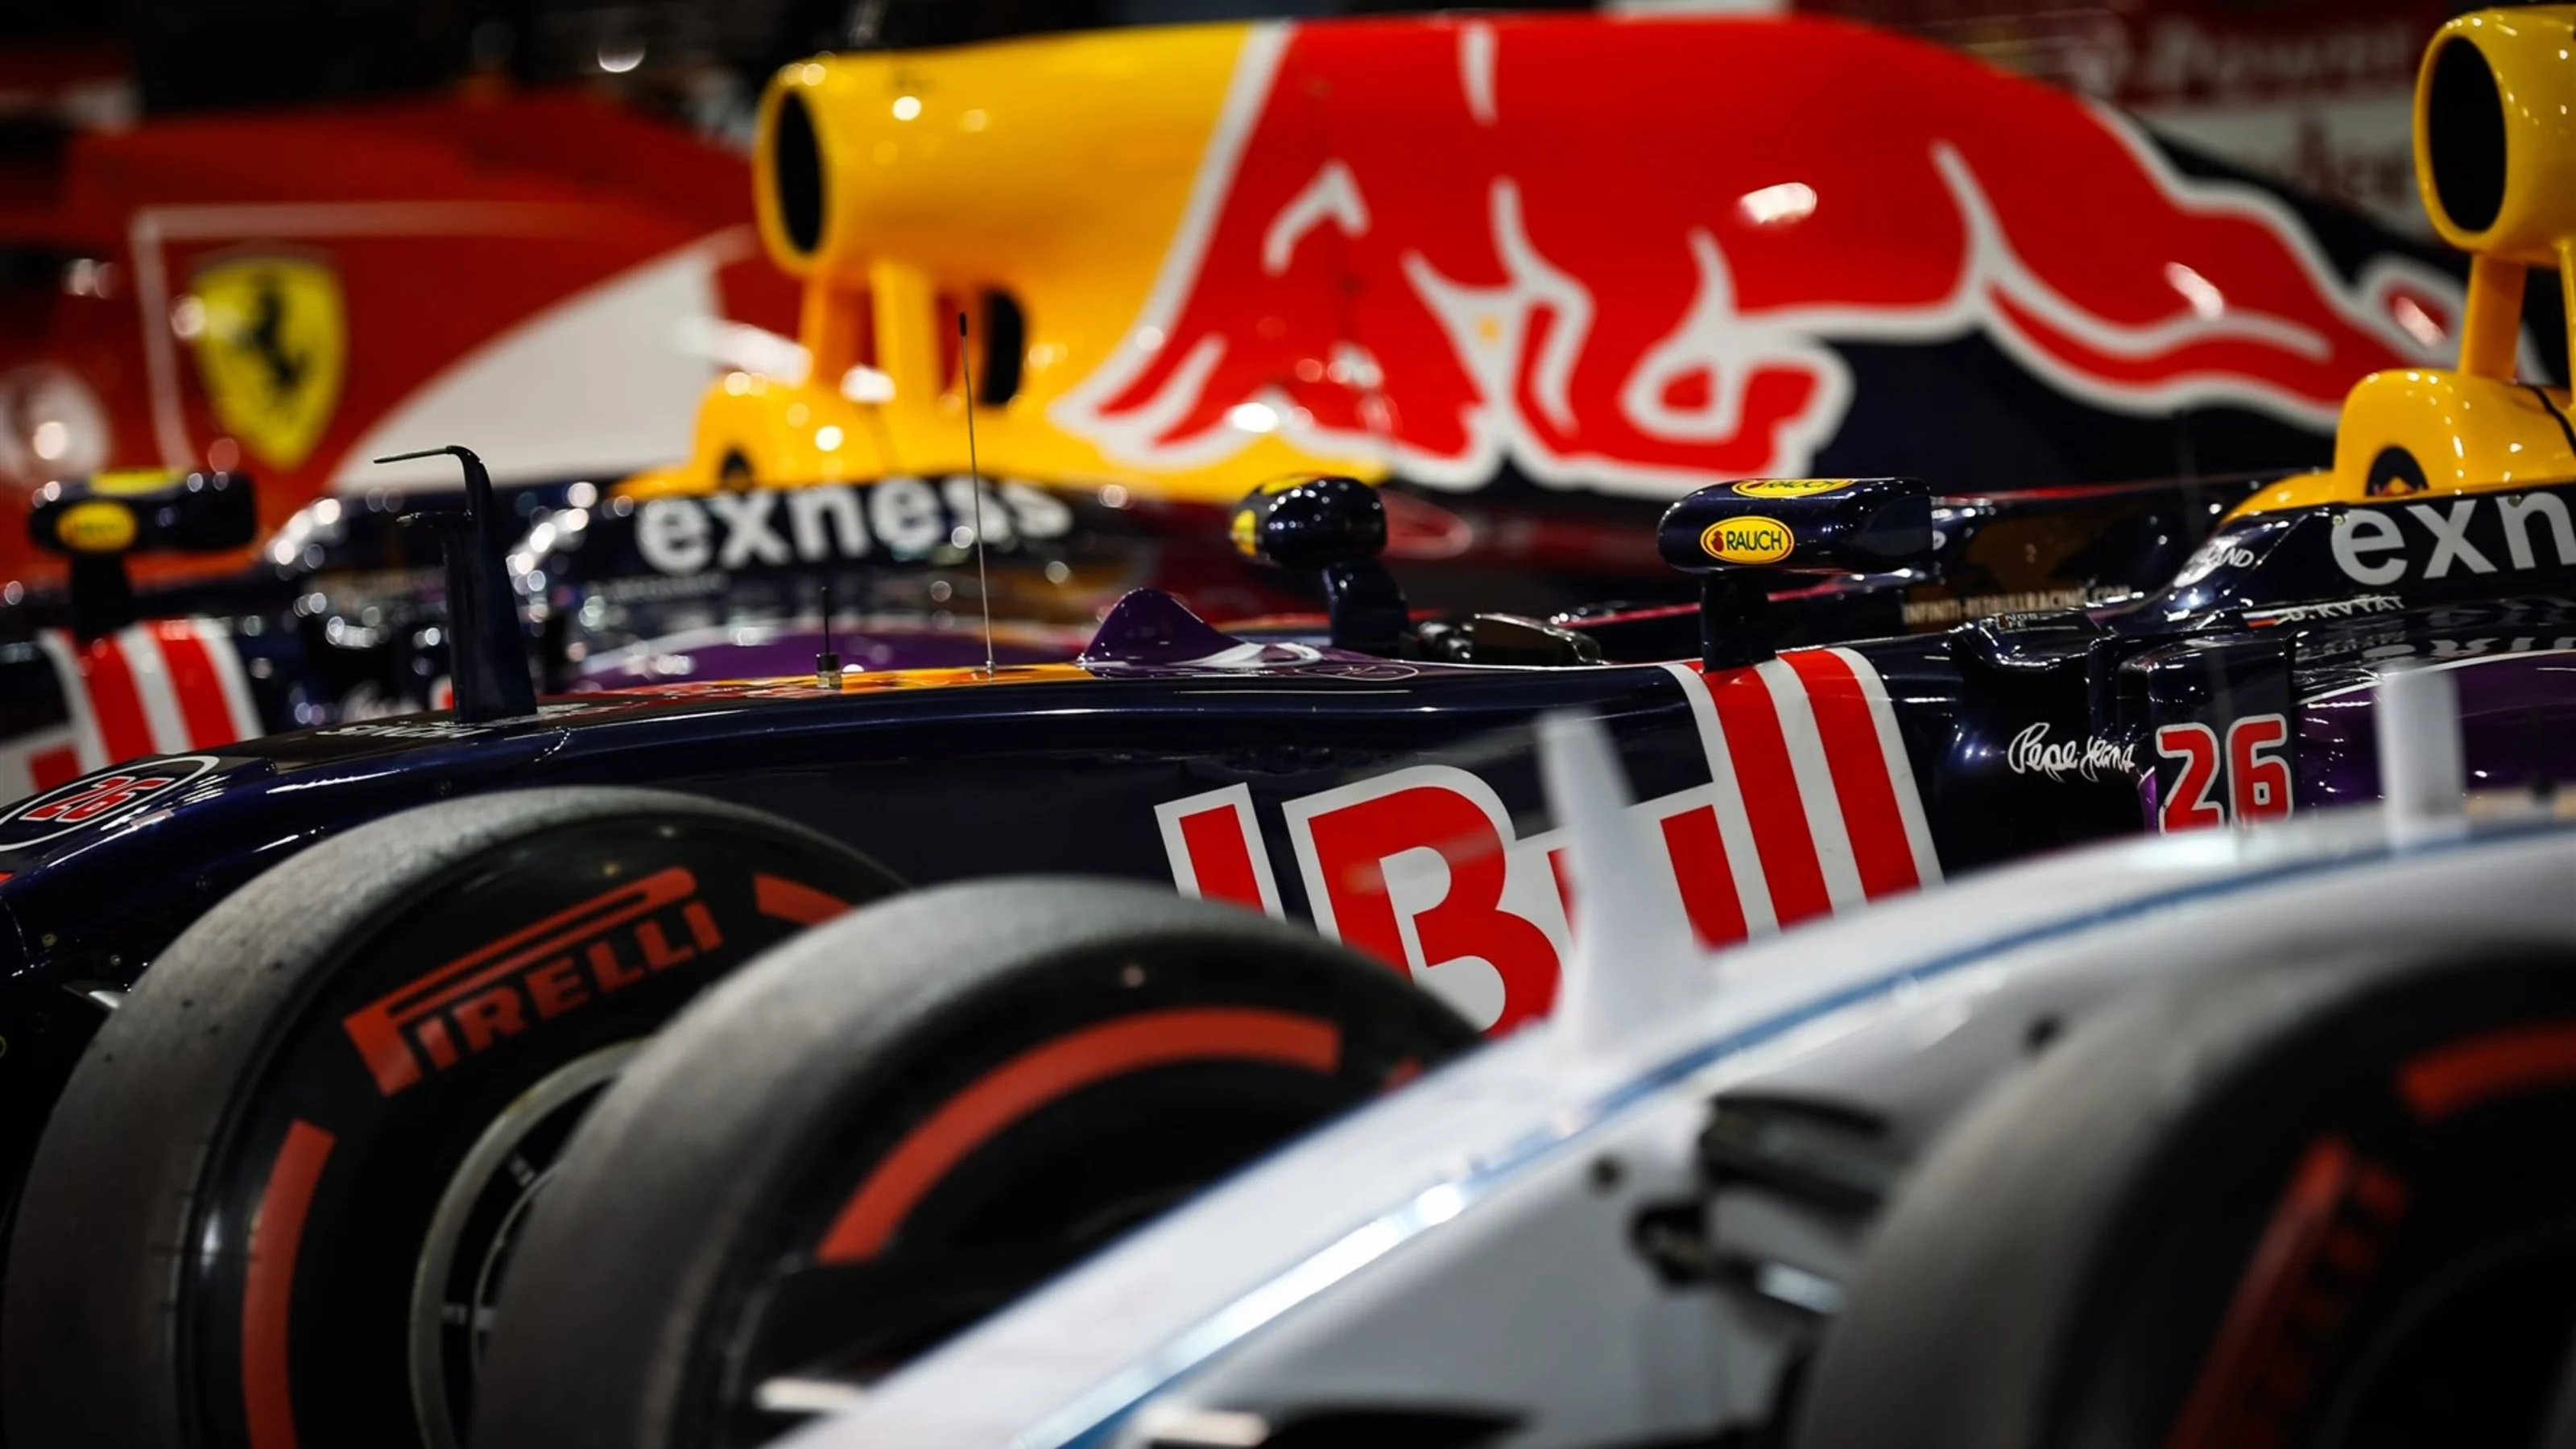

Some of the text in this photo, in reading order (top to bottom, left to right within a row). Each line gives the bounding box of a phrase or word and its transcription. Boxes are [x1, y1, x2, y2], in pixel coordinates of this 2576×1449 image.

[636, 477, 1073, 573] exness
[1726, 530, 1783, 551] RAUCH
[2008, 722, 2078, 783] Pepe
[2156, 713, 2293, 839] 26
[19, 776, 176, 822] 26
[341, 867, 722, 1097] PIRELLI
